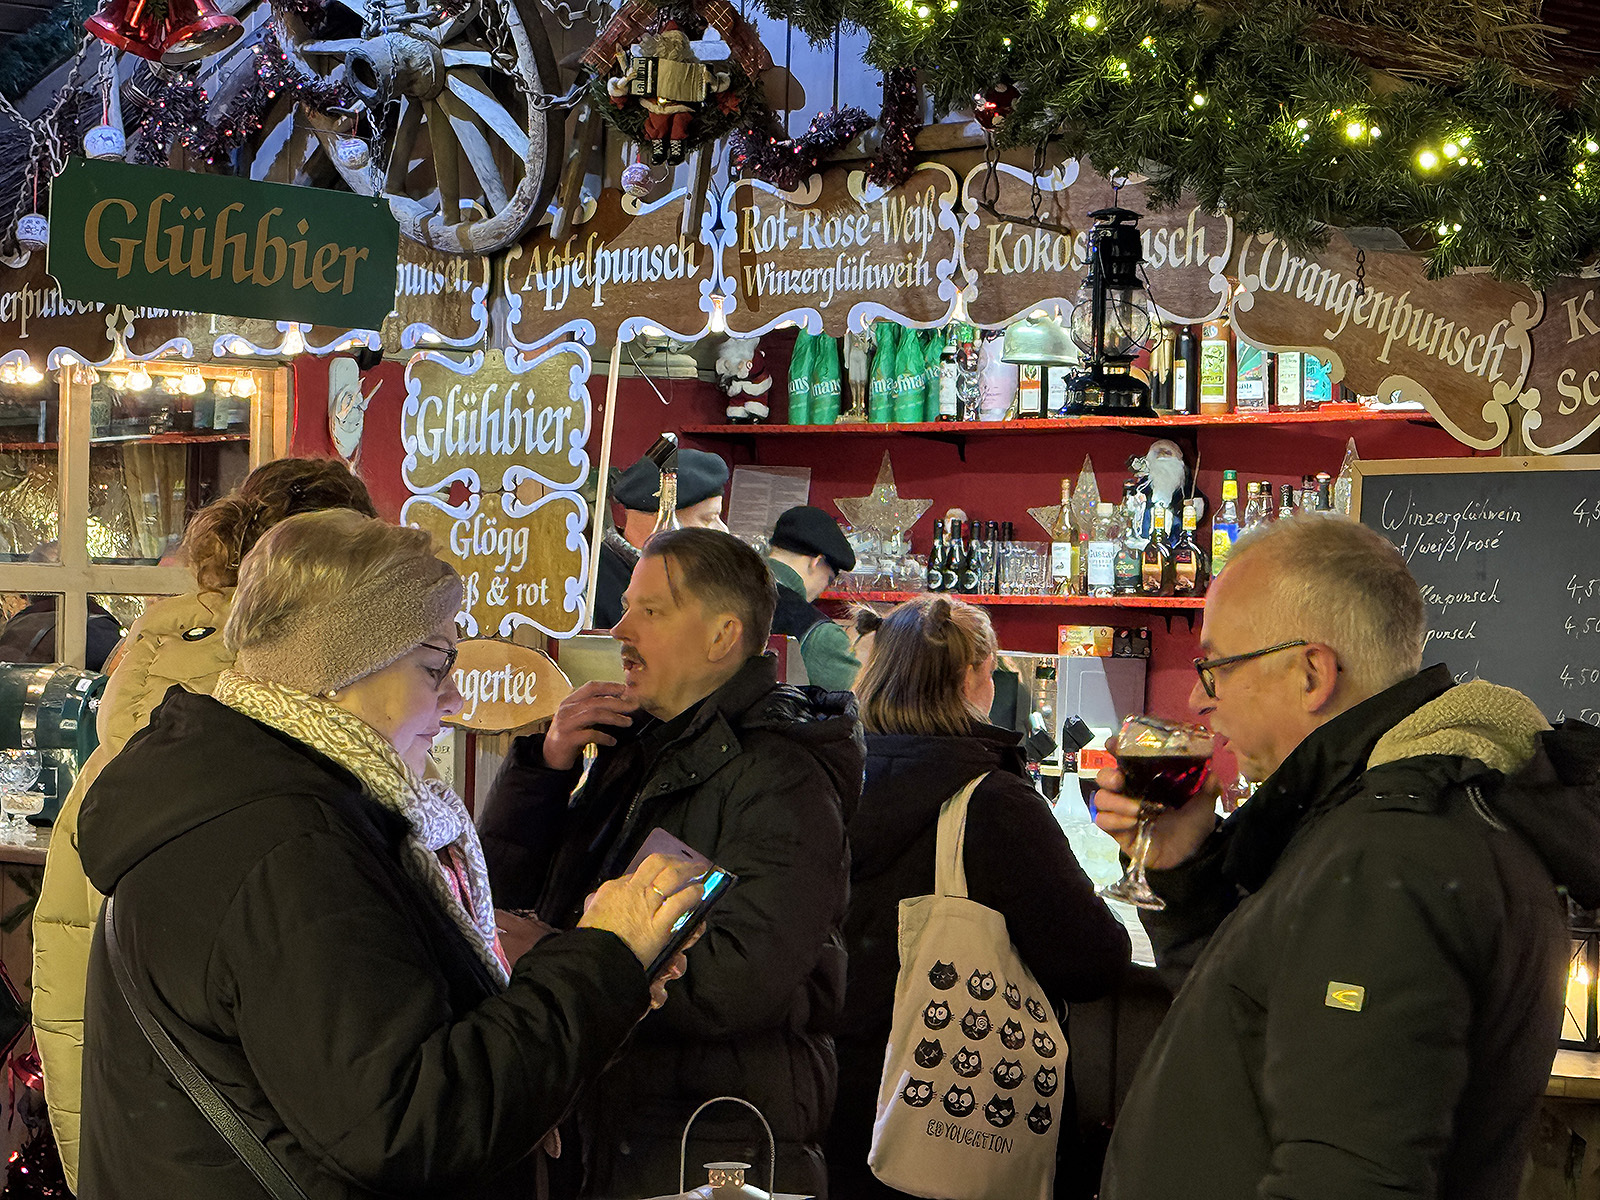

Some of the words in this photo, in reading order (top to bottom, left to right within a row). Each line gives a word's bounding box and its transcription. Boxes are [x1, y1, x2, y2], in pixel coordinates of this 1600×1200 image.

[84, 192, 370, 295] Glühbier
[521, 231, 700, 312] Apfelpunsch
[744, 251, 933, 308] Winzerglühwein
[1259, 233, 1510, 383] Orangenpunsch
[416, 382, 572, 465] Glühbier
[1382, 489, 1521, 534] Winzerglühwein
[1573, 498, 1600, 528] 4,5
[450, 513, 530, 572] Glögg
[1400, 530, 1504, 565] t/weiß/rosé
[486, 576, 509, 606] &
[516, 578, 550, 606] rot
[1566, 574, 1600, 604] 4,5
[1421, 621, 1477, 653] punsch
[452, 663, 537, 720] agertee
